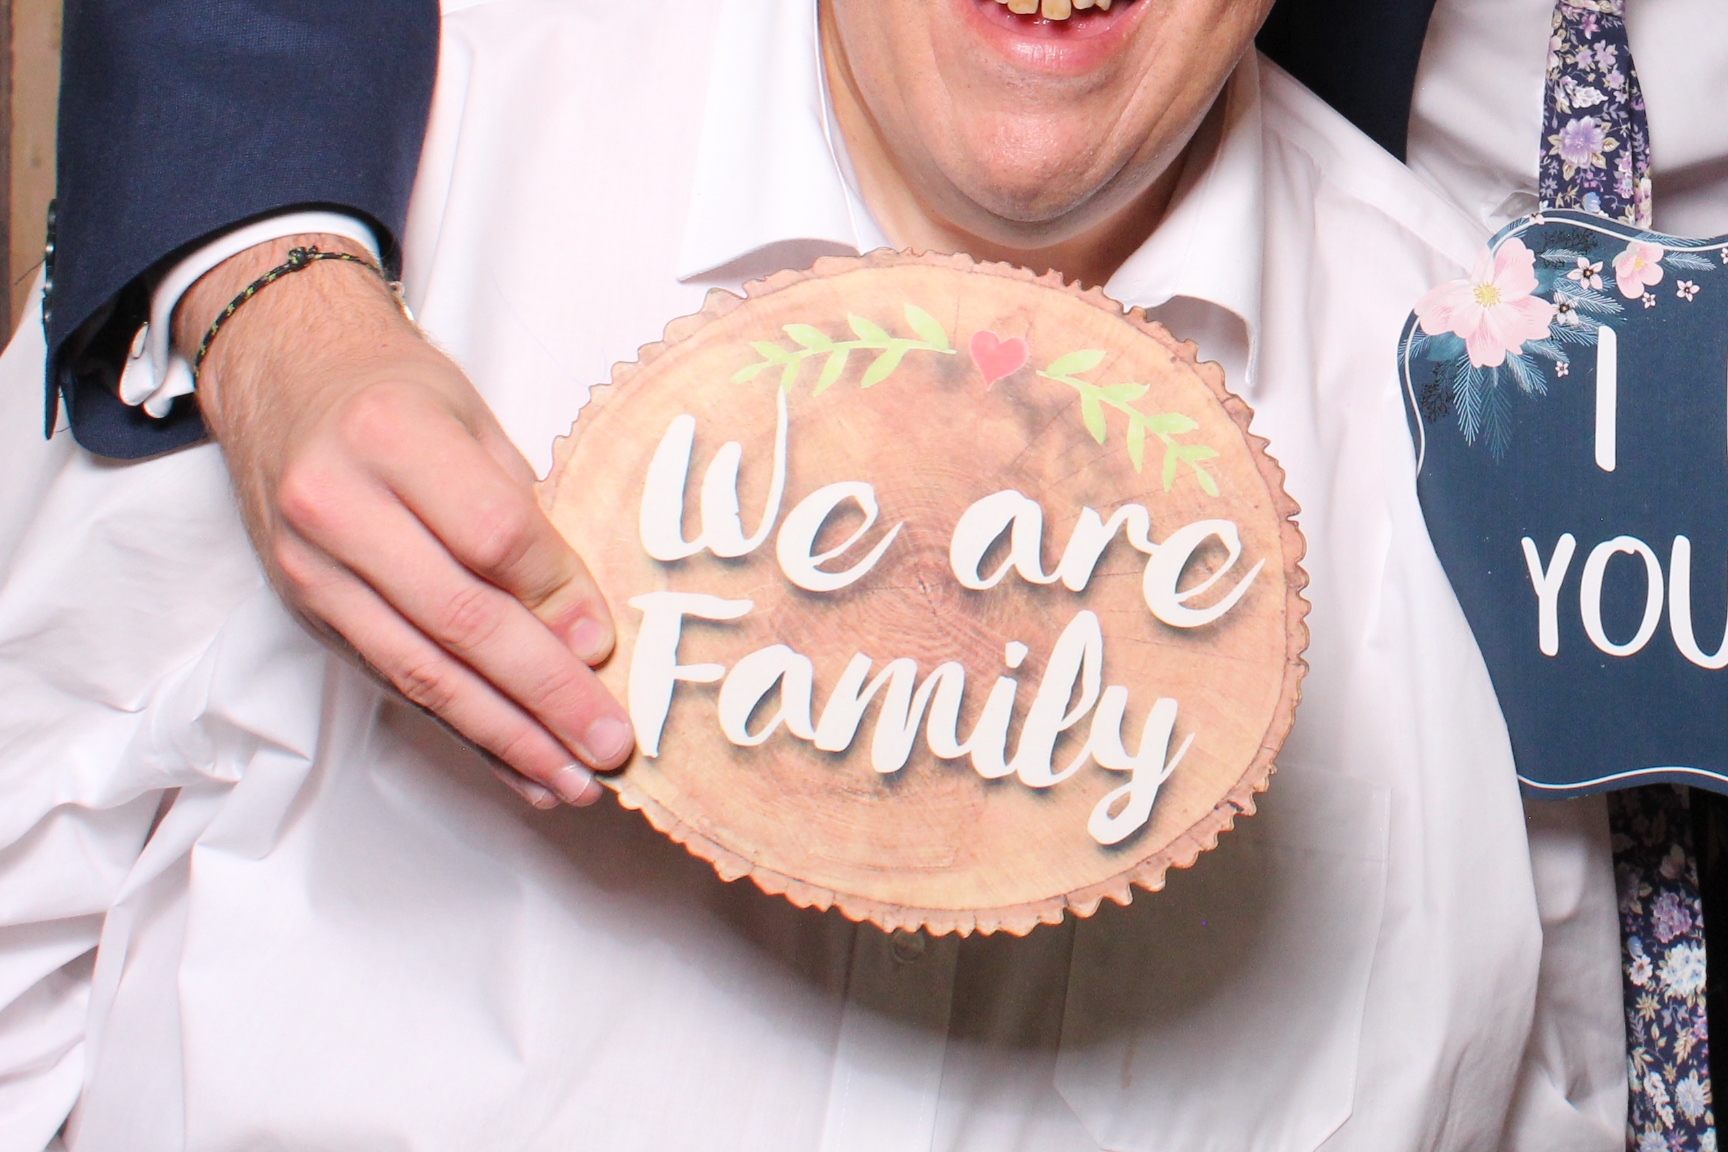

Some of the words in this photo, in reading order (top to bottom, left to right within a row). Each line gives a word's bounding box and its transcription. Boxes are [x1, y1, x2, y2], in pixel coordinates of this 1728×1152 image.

[639, 384, 905, 591] We
[950, 489, 1265, 627] are
[1594, 324, 1618, 472] I
[628, 590, 1196, 845] Family
